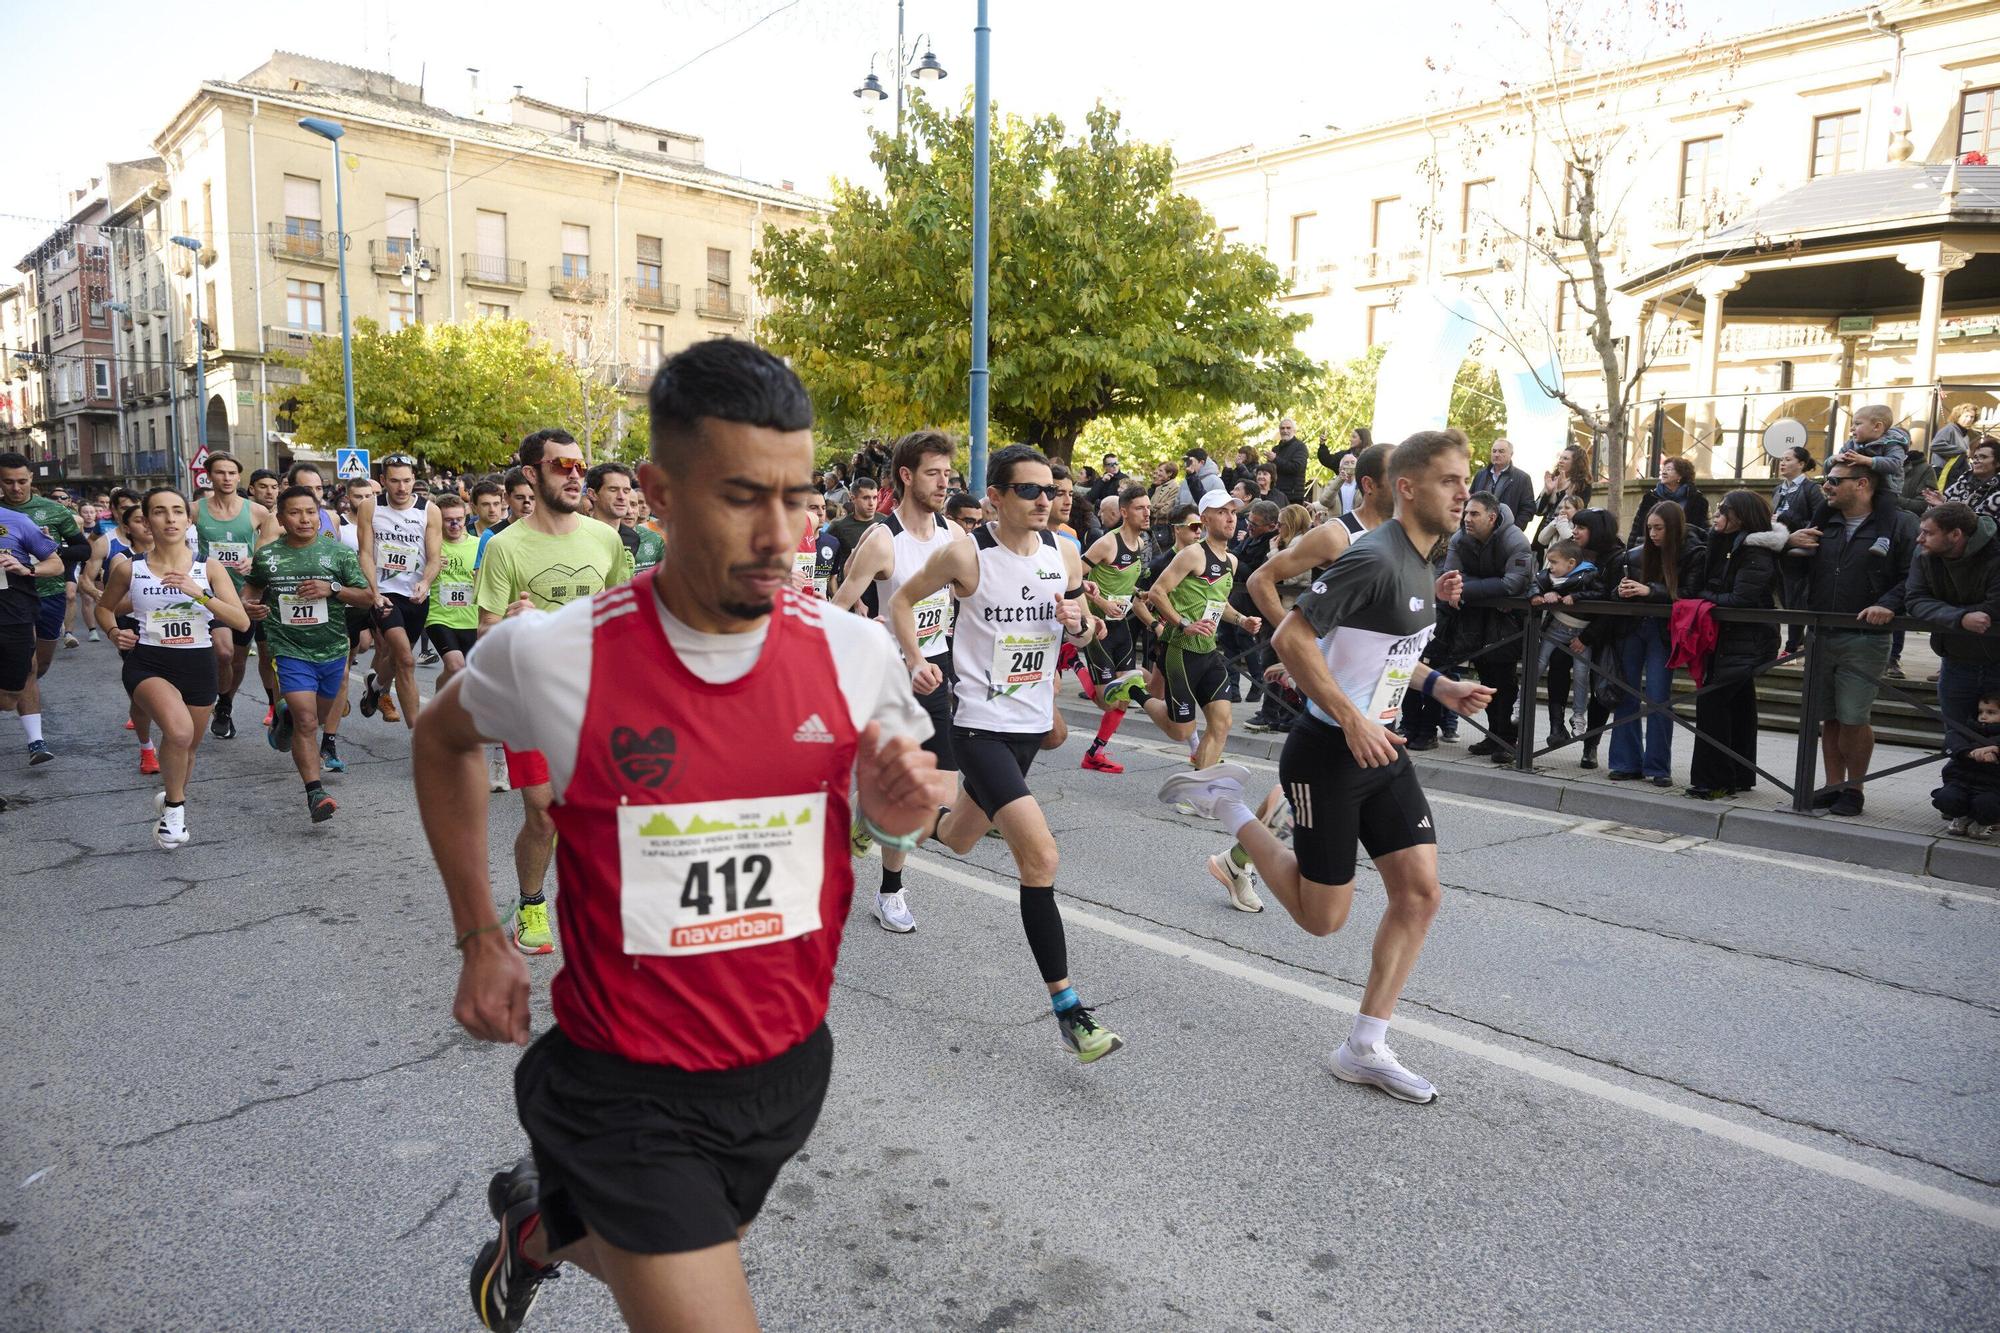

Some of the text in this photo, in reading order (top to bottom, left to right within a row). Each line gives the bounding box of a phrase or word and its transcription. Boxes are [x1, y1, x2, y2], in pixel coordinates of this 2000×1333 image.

[218, 551, 239, 561] 205
[387, 553, 407, 565] 146
[451, 591, 465, 601] 86
[292, 605, 314, 618] 217
[918, 608, 942, 629] 228
[984, 601, 1058, 622] etxenik
[161, 621, 192, 637] 106
[1010, 650, 1045, 673] 240
[679, 854, 773, 916] 412
[676, 916, 781, 945] navarban
